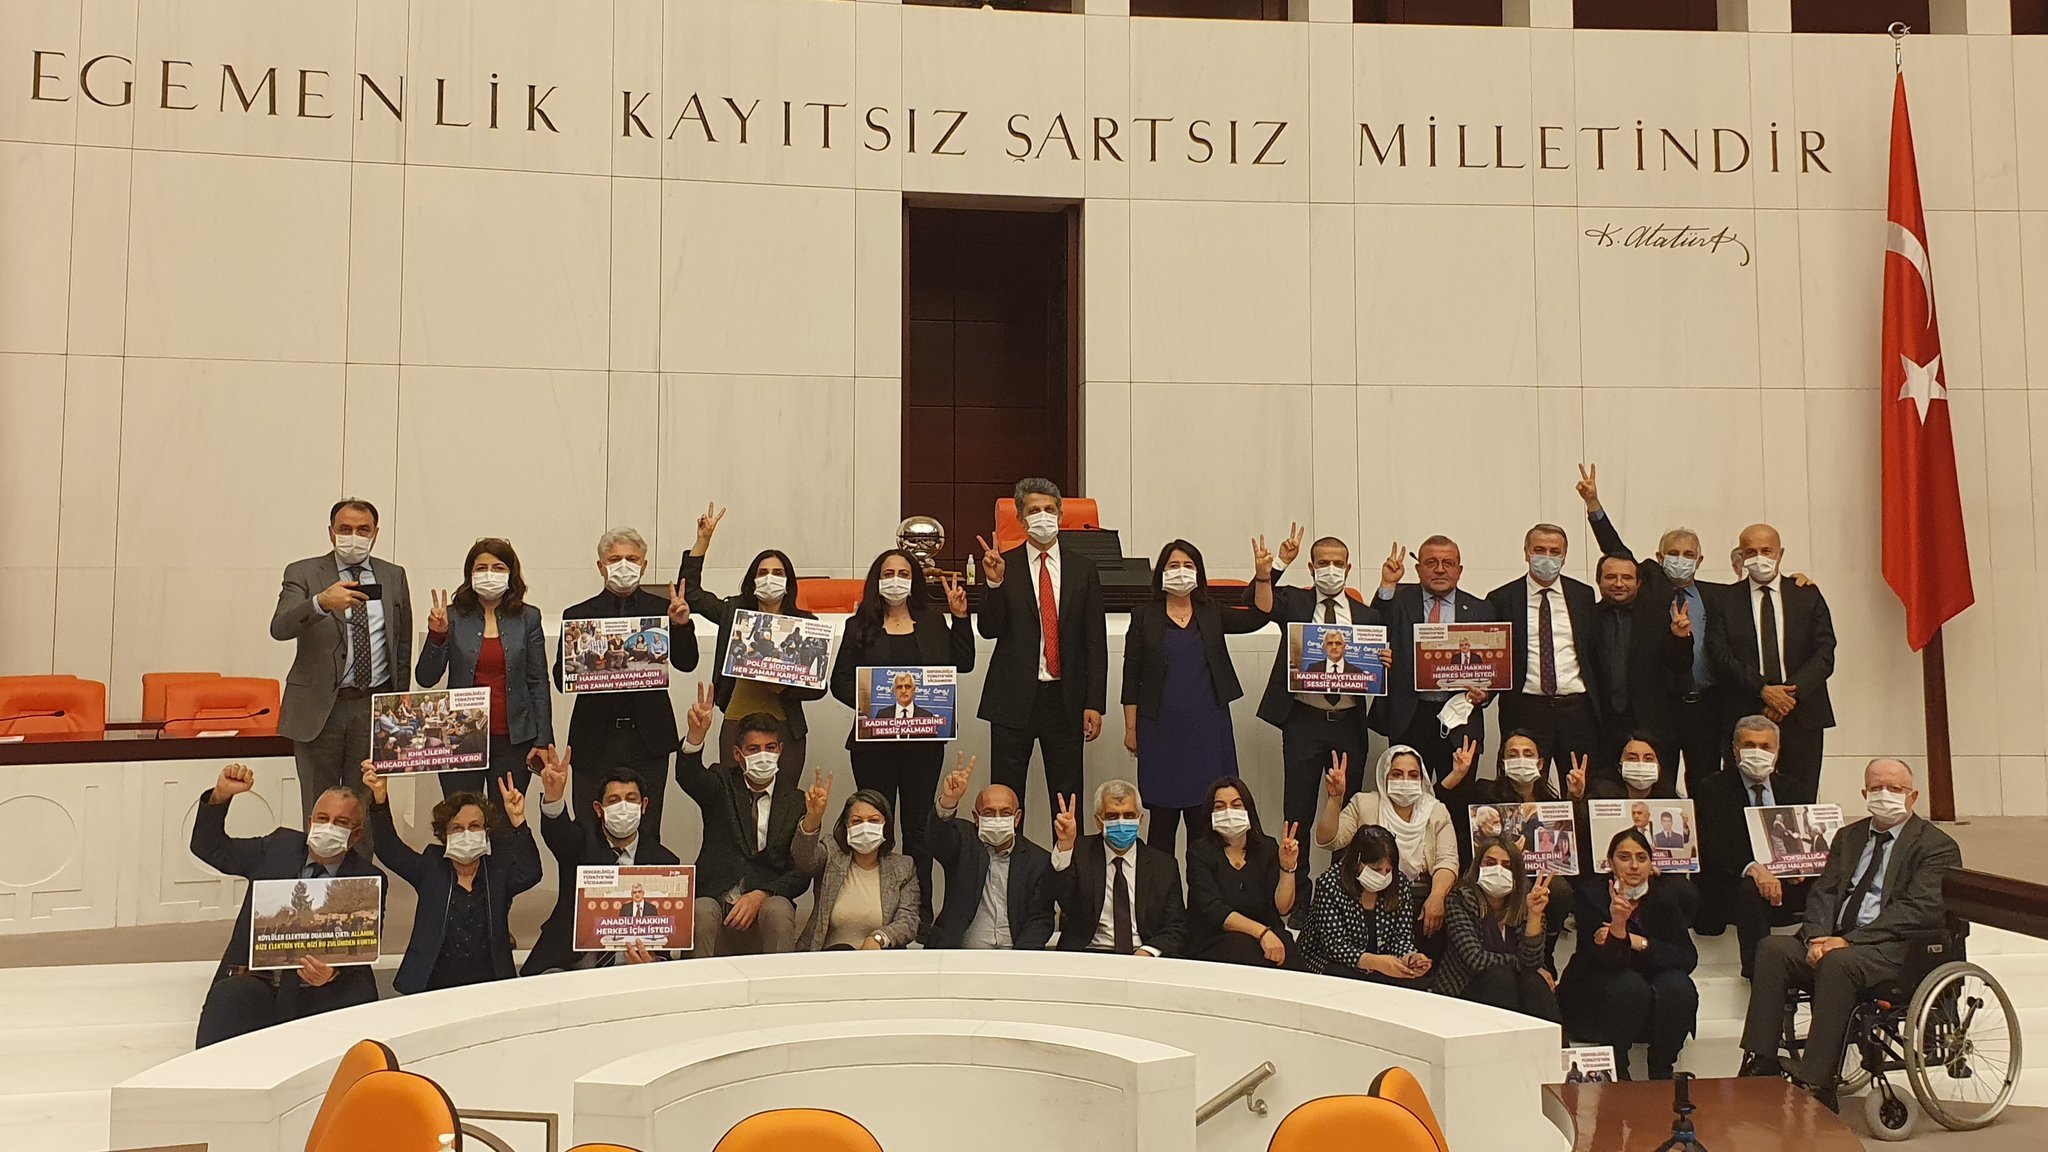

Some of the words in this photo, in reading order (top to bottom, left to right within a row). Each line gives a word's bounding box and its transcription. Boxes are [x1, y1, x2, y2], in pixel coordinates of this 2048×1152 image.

[29, 49, 561, 134] EGEMENLİK
[621, 89, 968, 157] KAYITSIZ
[1004, 111, 1290, 166] ŞARTSIZ
[1357, 114, 1834, 176] MİLLETİNDİR
[746, 660, 768, 668] POLİS
[768, 663, 807, 673] ŞİDDETİNE
[1435, 664, 1462, 672] ANADİLİ
[579, 674, 609, 682] HAKKINI
[610, 671, 660, 680] ARAYANLARIN
[748, 667, 776, 677] ZAMAN
[776, 670, 798, 680] KARŞI
[799, 674, 818, 682] ÇIKTI
[1319, 673, 1374, 682] CİNAYETLERİNE
[1459, 672, 1473, 680] İÇİN
[1474, 670, 1495, 678] İSTEDİ
[590, 682, 614, 690] ZAMAN
[614, 680, 644, 688] YANINDA
[645, 678, 664, 686] OLDU
[1306, 680, 1330, 688] SESSİZ
[865, 719, 888, 727] KADIN
[889, 717, 944, 727] CİNAYETLERİNE
[875, 726, 900, 735] SESSİZ
[900, 726, 933, 734] KALMADI
[408, 748, 451, 758] KHK'LİLERİN
[376, 758, 432, 770] MÜCADELESİNE
[432, 756, 459, 765] DESTEK
[460, 753, 482, 762] VERDİ
[600, 916, 634, 926] ANADİLİ
[635, 917, 669, 925] HAKKINI
[596, 927, 628, 935] HERKES
[629, 926, 646, 936] İÇİN
[647, 924, 673, 934] İSTEDİ
